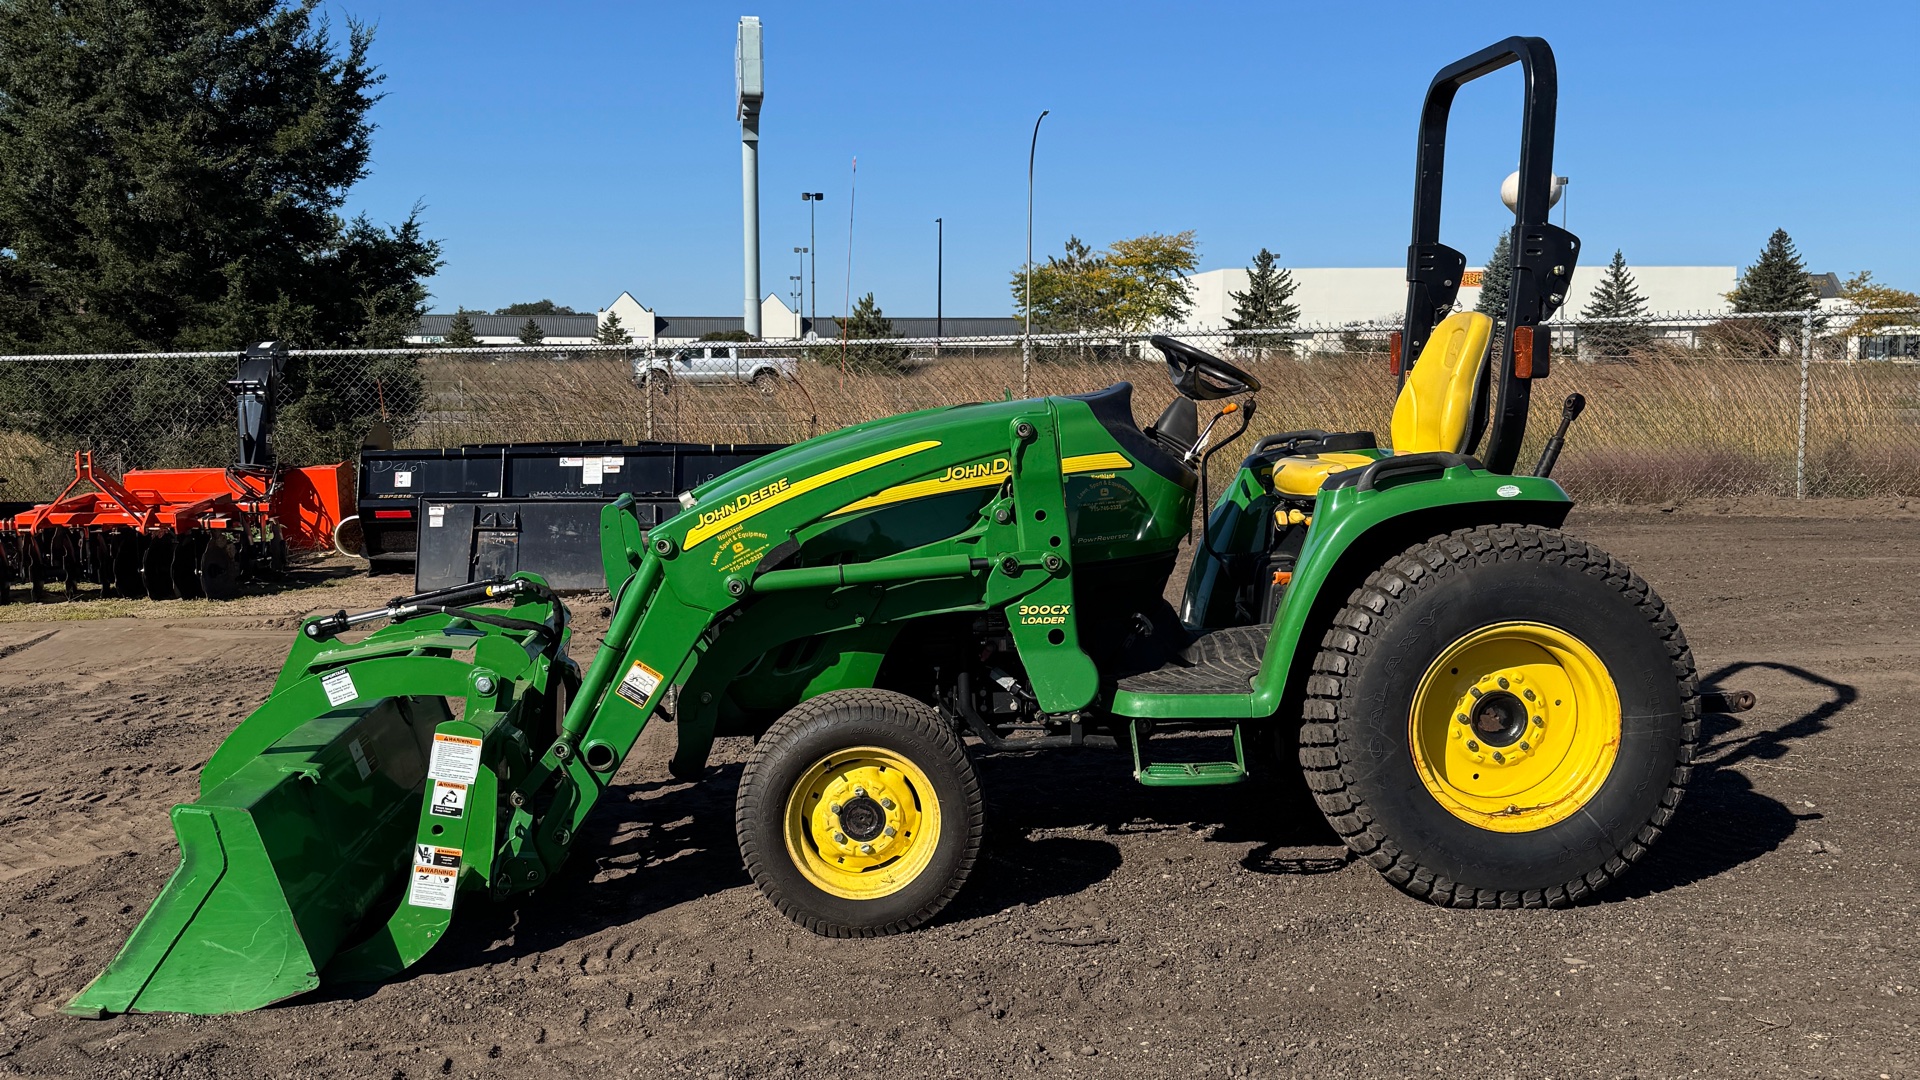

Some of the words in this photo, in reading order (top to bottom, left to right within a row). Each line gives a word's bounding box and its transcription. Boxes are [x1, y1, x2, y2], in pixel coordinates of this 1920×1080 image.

[940, 462, 990, 483] JOHN
[695, 501, 736, 530] JOHN
[736, 477, 790, 510] DEERE
[717, 523, 744, 542] Northland
[1077, 532, 1130, 544] PowrReverser
[720, 536, 734, 552] Sport
[738, 530, 768, 540] Equipment
[1018, 604, 1071, 615] 300CX
[1021, 616, 1066, 625] LOADER
[1369, 607, 1438, 760] GALAXY
[449, 736, 473, 745] WARNING
[443, 782, 466, 790] WARNING
[424, 867, 454, 877] WARNING
